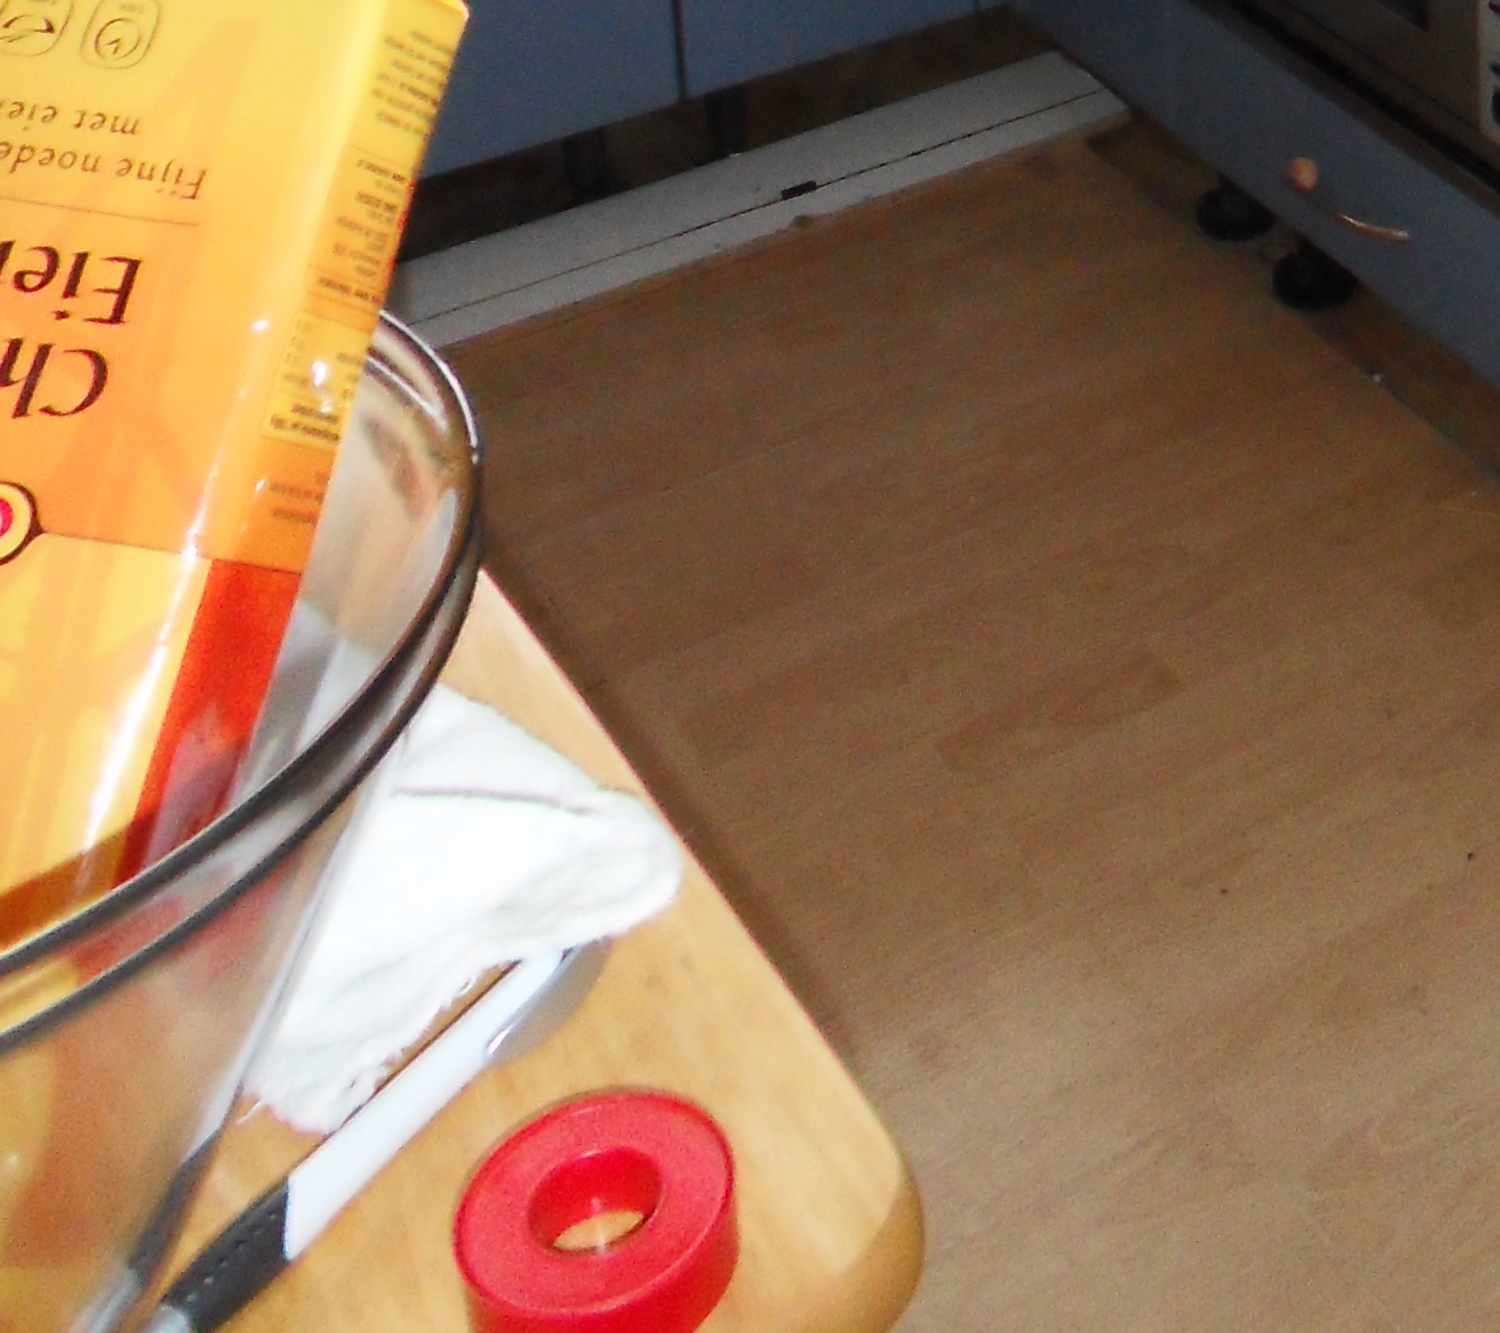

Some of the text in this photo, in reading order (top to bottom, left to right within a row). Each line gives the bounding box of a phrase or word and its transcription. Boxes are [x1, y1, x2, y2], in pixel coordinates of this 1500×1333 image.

[0, 100, 140, 136] met eie
[115, 158, 207, 201] Fijne
